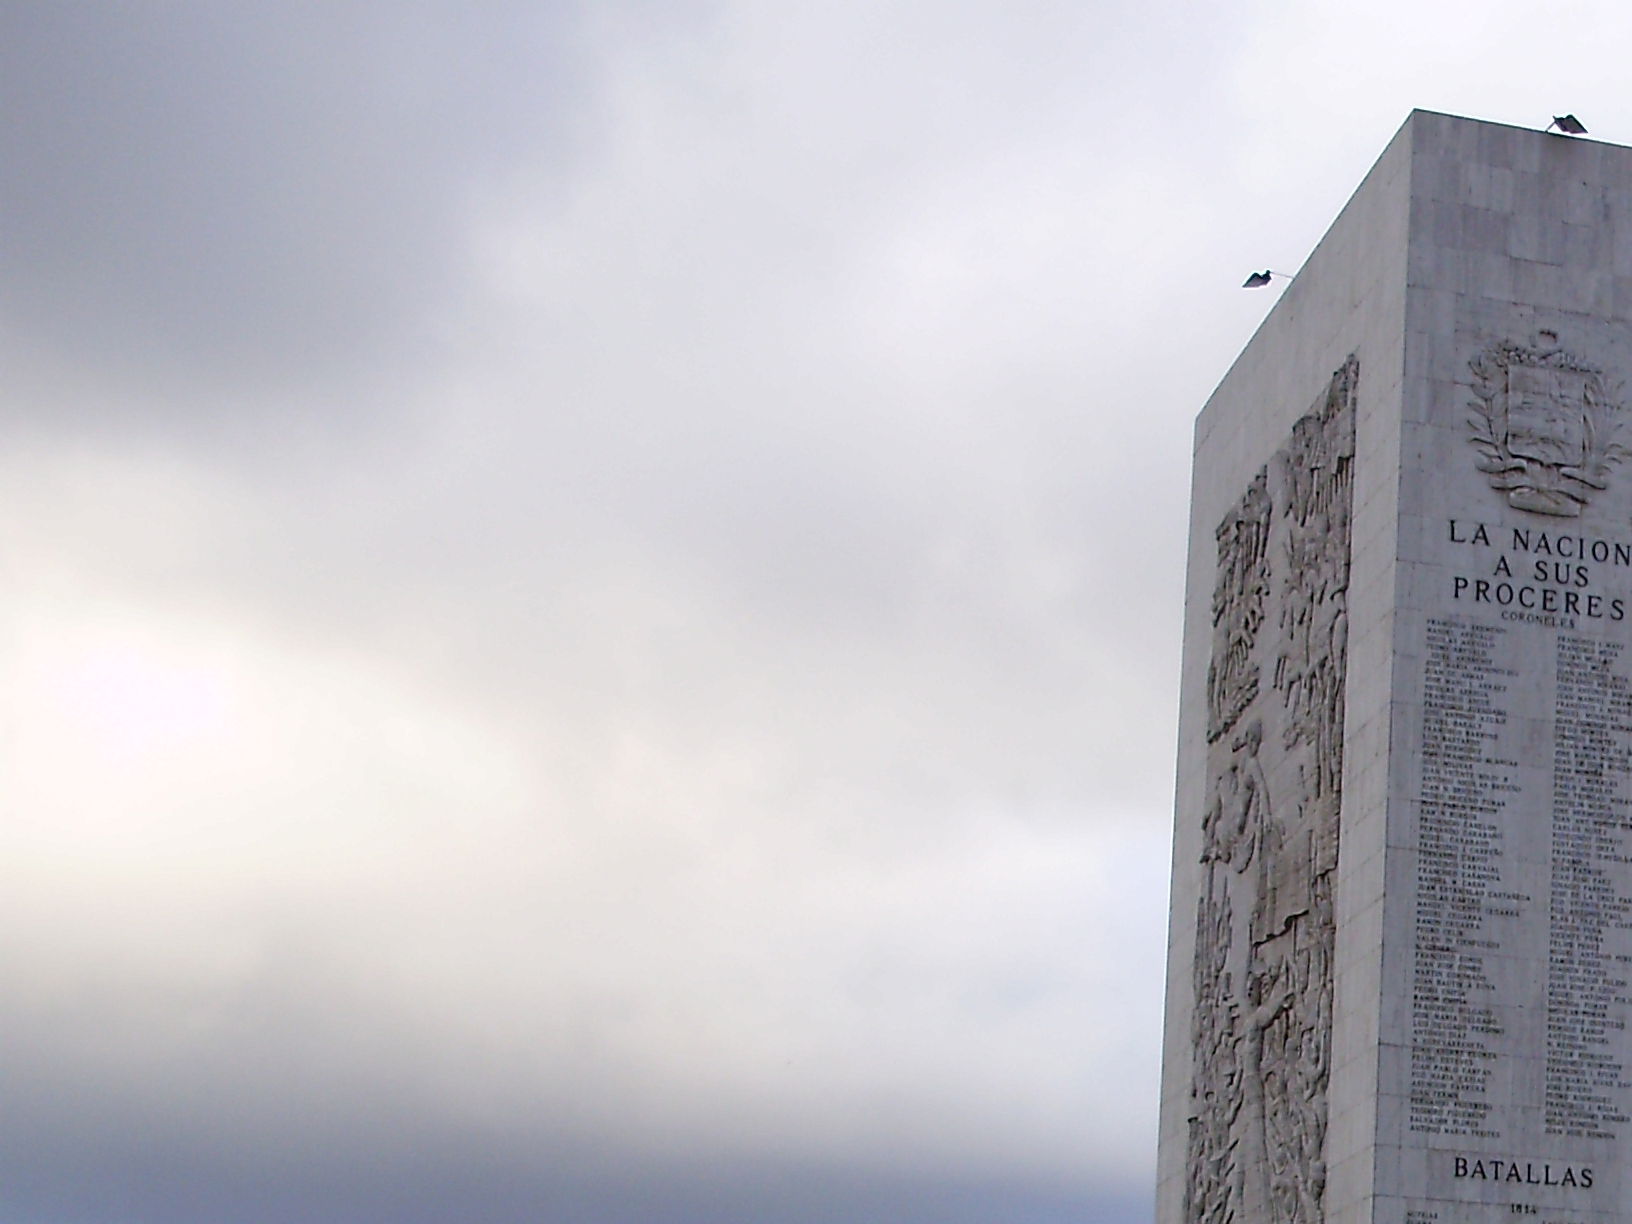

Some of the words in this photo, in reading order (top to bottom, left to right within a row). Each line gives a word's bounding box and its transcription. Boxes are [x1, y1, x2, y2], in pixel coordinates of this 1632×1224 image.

[1449, 520, 1491, 547] LA
[1512, 528, 1632, 567] NACION
[1494, 556, 1513, 578] A
[1534, 562, 1590, 588] SUS
[1453, 576, 1626, 621] PROCERES
[1501, 610, 1576, 630] CORONELES
[1454, 1157, 1595, 1189] BATALLAS
